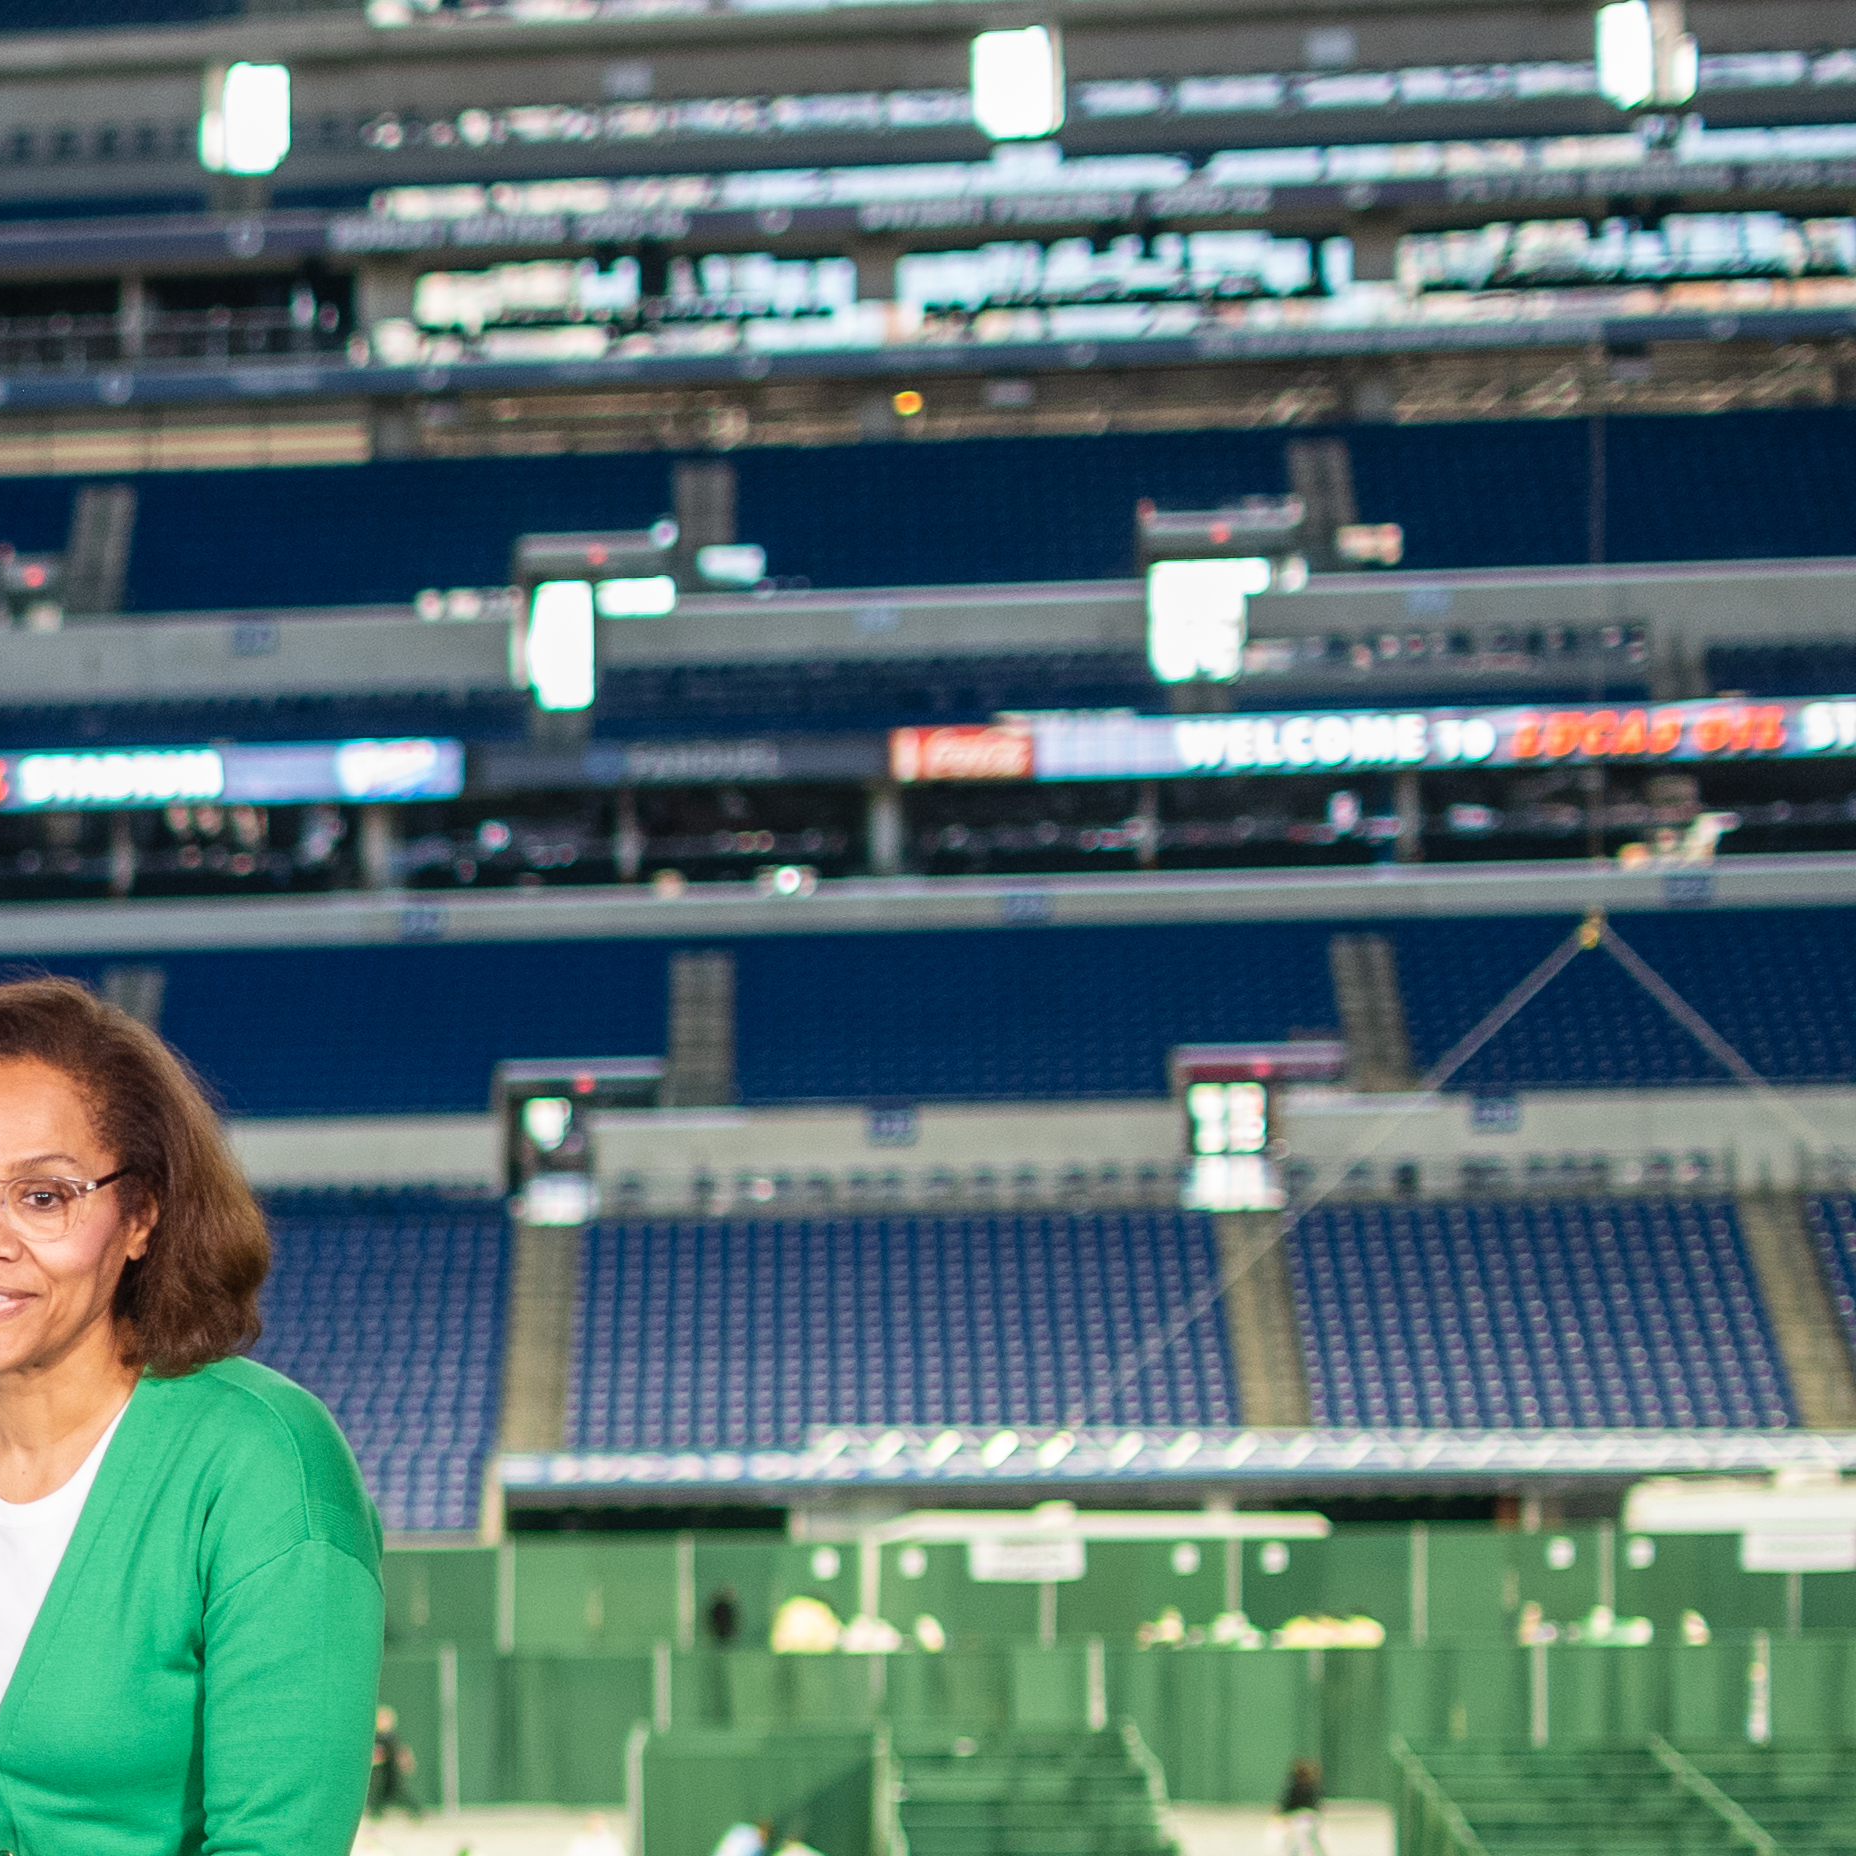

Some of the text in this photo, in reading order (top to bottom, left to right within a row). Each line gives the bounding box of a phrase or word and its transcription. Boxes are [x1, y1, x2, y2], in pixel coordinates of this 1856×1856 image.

[1174, 714, 1429, 770] WELCOME
[1434, 718, 1496, 762] TO
[1511, 706, 1683, 758] LUCAS
[1690, 704, 1787, 753] OIL
